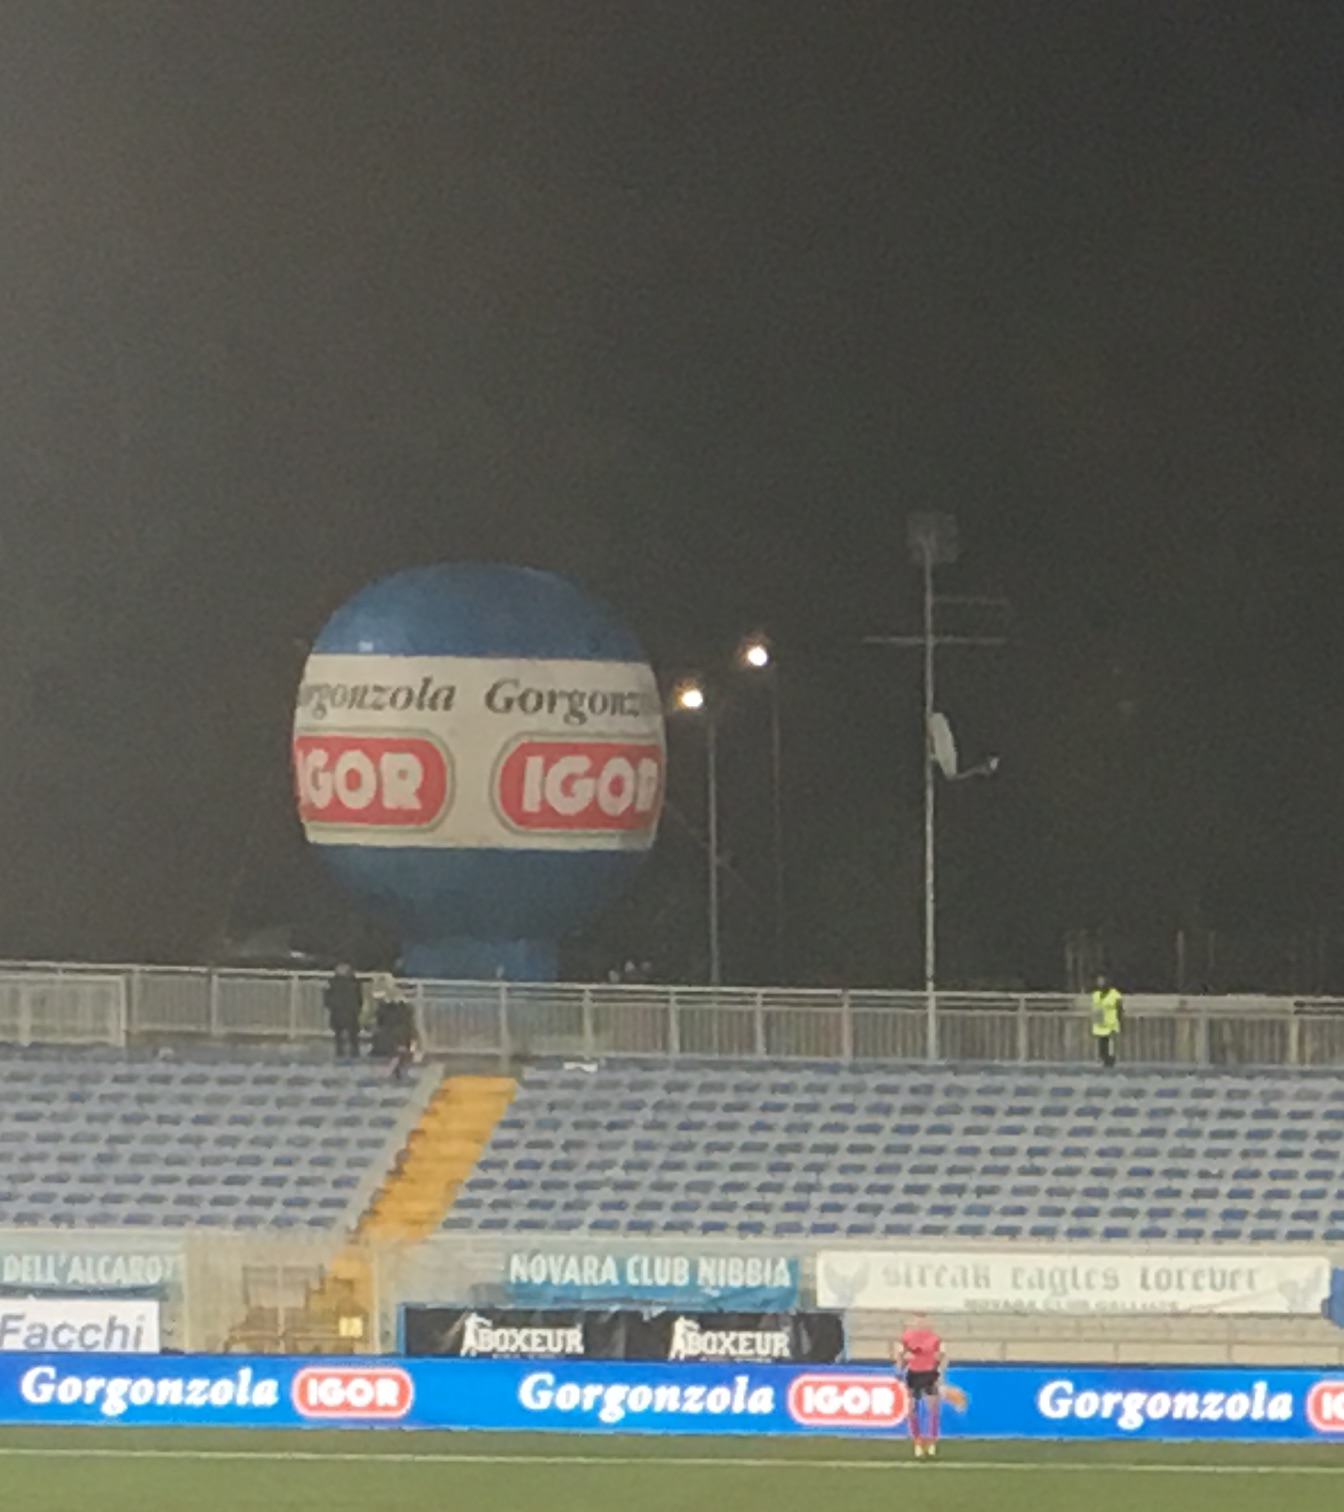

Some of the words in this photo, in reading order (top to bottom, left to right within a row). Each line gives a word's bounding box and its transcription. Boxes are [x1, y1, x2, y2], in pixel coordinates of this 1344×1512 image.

[510, 1254, 620, 1285] NOVARA
[627, 1255, 690, 1287] CLUB
[698, 1257, 791, 1288] NIBBIA
[0, 1313, 146, 1350] Facchi
[21, 1366, 278, 1416] Gorgonzola
[307, 1377, 400, 1408] IGOR
[519, 1372, 774, 1423] Gorgonzola
[803, 1385, 895, 1415] IGOR
[1037, 1380, 1293, 1430] Gorgonzola
